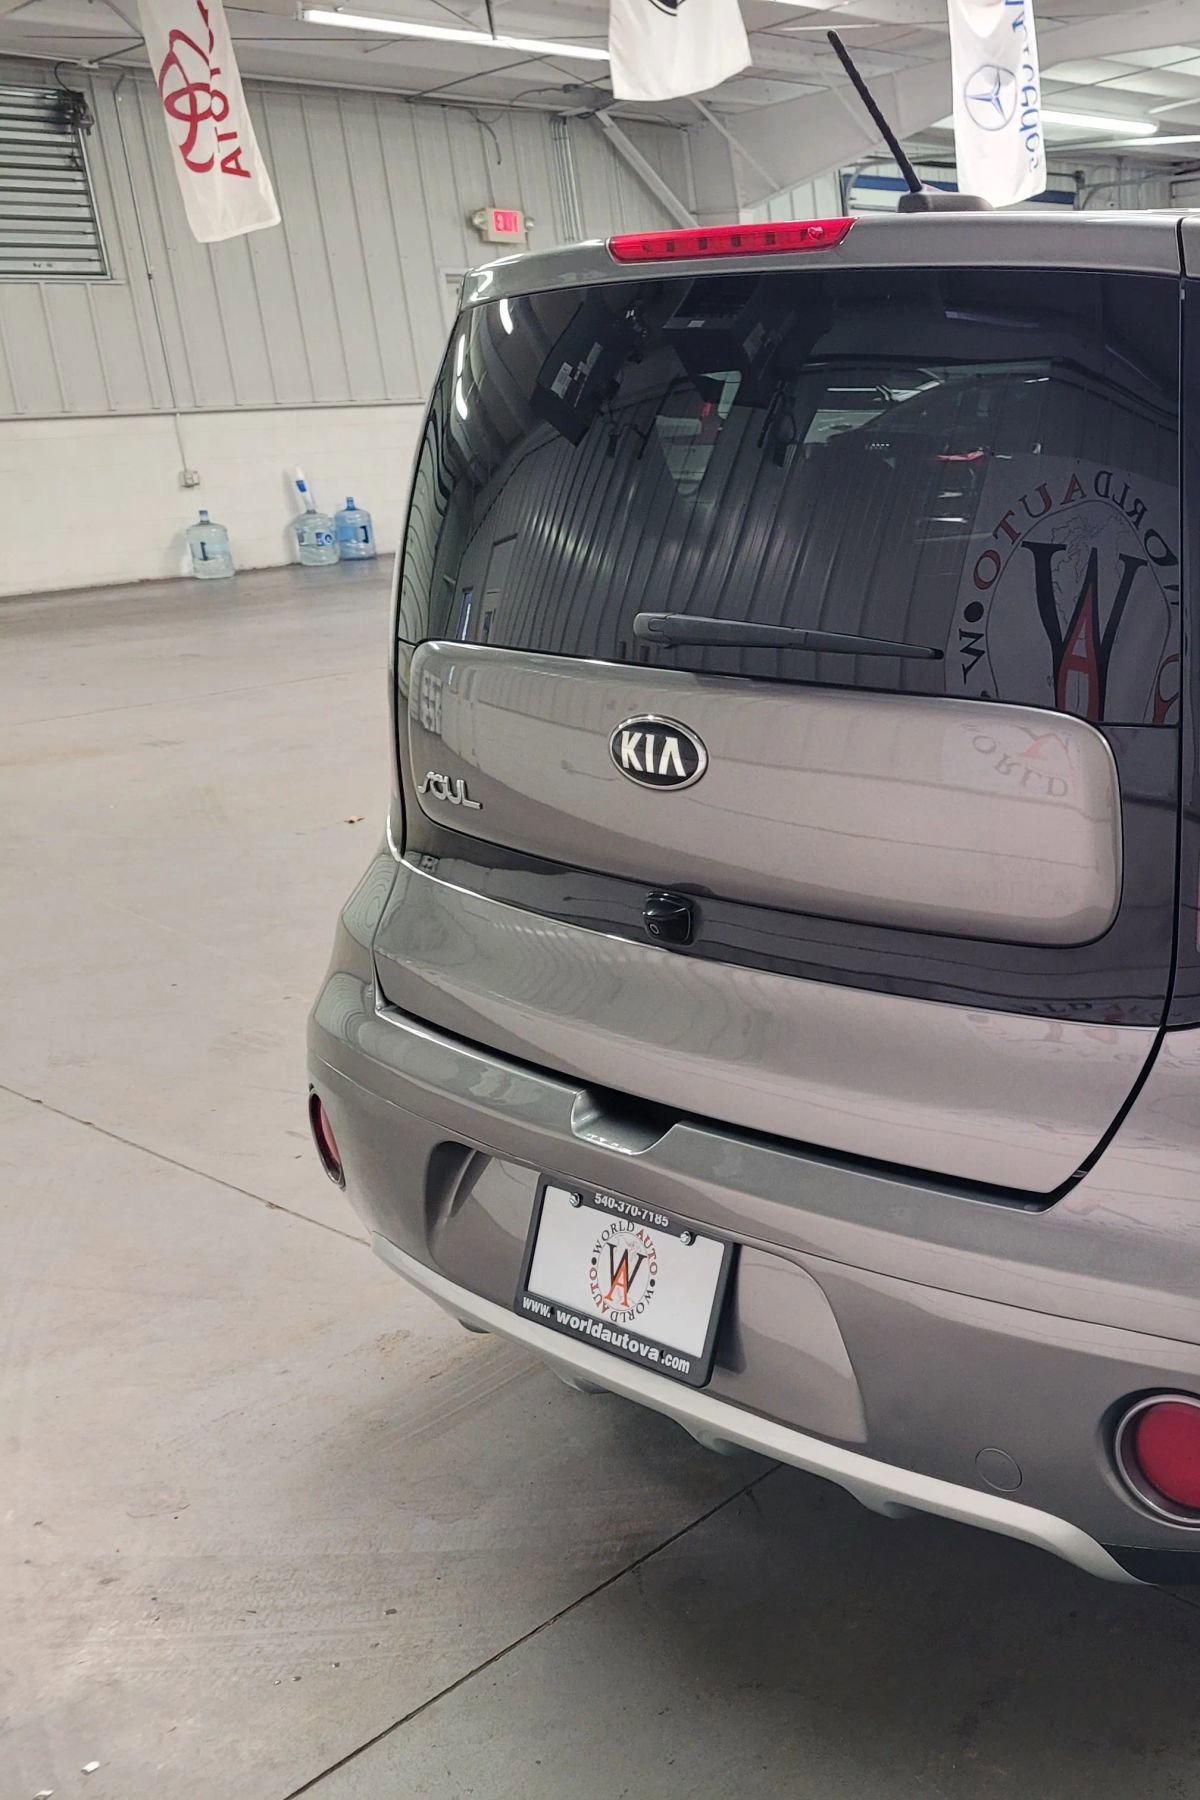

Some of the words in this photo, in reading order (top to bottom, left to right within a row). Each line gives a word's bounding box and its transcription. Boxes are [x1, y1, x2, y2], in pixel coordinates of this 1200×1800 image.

[620, 730, 687, 777] KIA
[417, 771, 482, 809] SOUL
[594, 1192, 669, 1227] 540-370-7185
[592, 1219, 635, 1254] WORLD
[635, 1228, 659, 1276] AUTO
